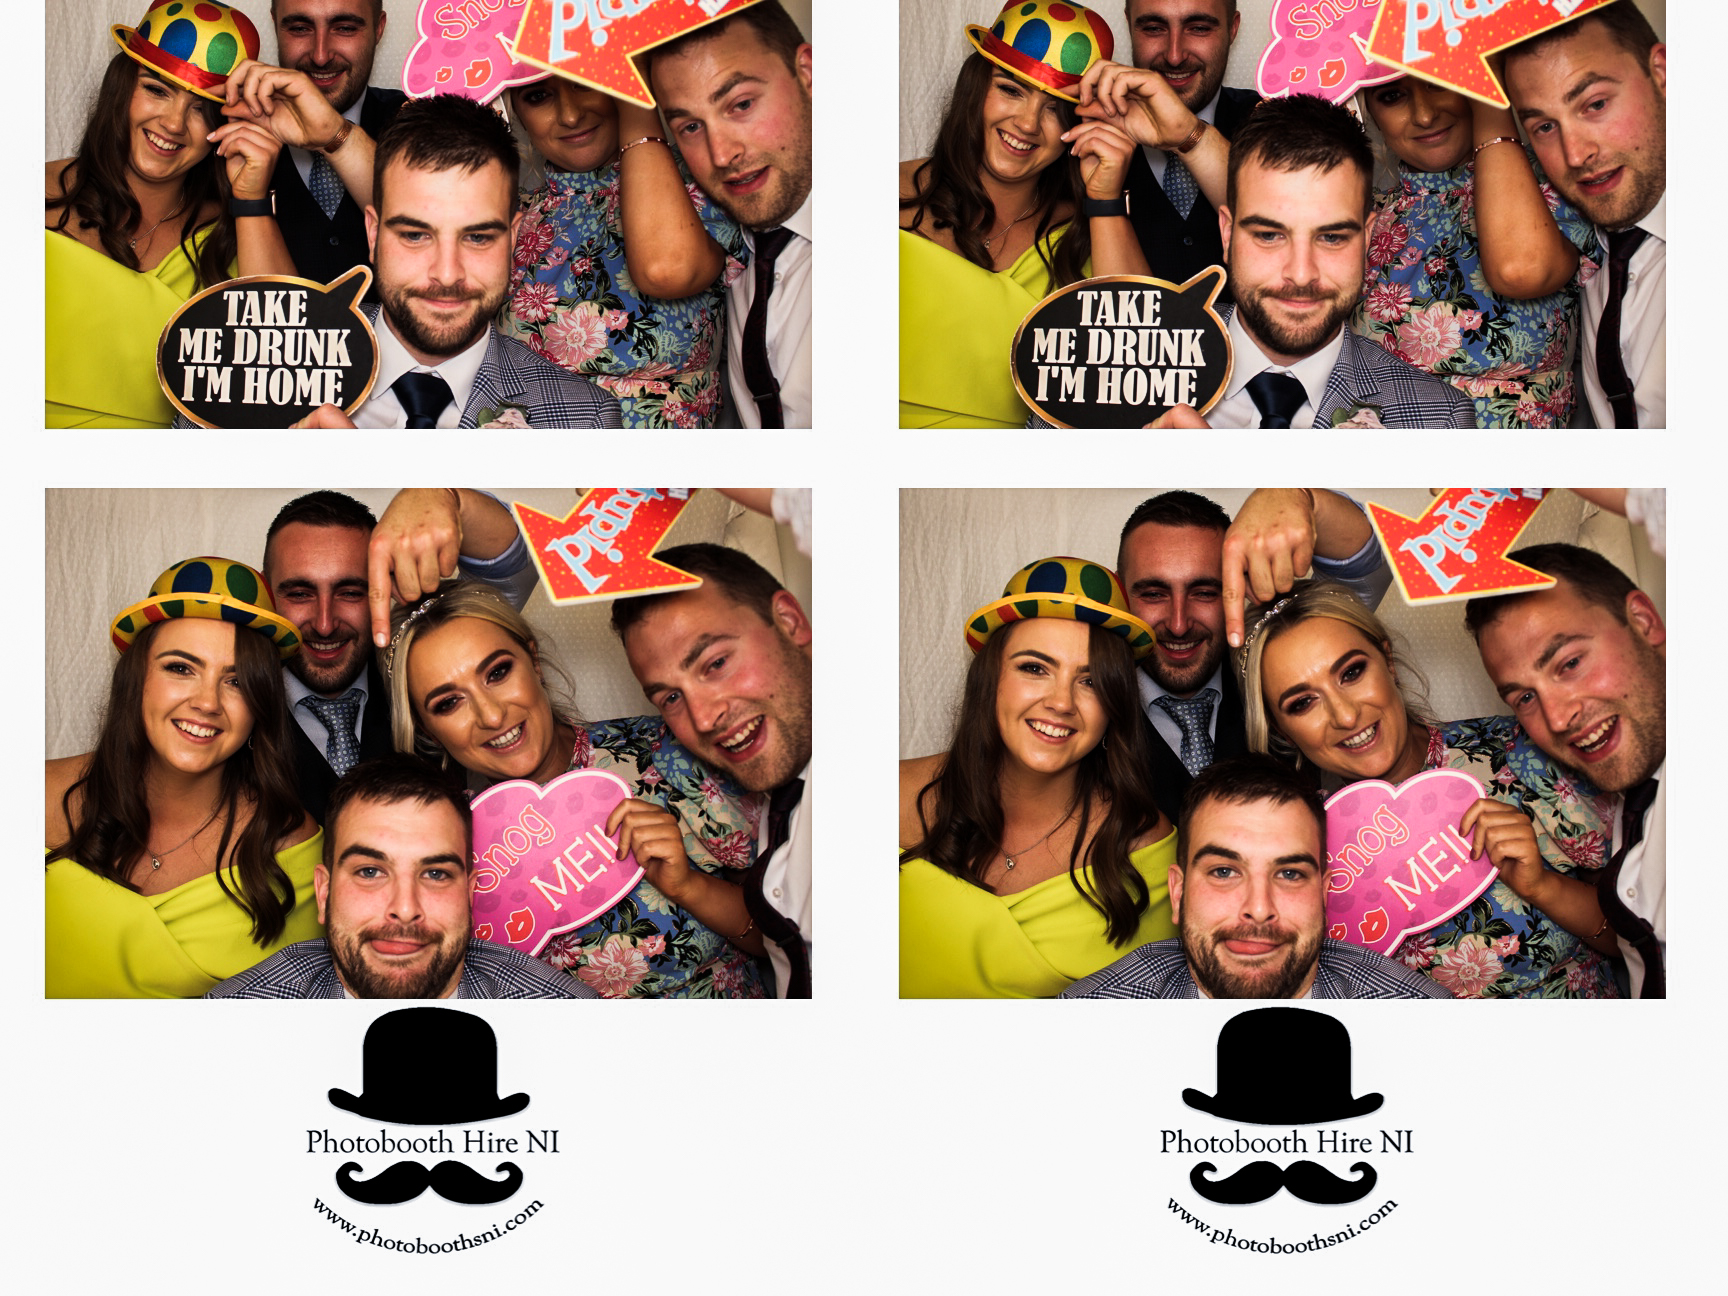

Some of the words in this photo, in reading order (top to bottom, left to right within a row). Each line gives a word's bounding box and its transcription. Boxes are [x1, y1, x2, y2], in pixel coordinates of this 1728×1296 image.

[223, 290, 308, 327] TAKE
[1077, 290, 1162, 327] TAKE
[177, 328, 223, 364] ME
[231, 329, 352, 367] DRUNK
[1031, 328, 1077, 364] ME
[1085, 329, 1206, 367] DRUNK
[181, 365, 233, 403] I'M
[241, 367, 344, 408] HOME
[1035, 365, 1087, 403] I'M
[1095, 367, 1198, 408] HOME
[544, 488, 665, 594] tupid
[1398, 488, 1519, 594] tupid
